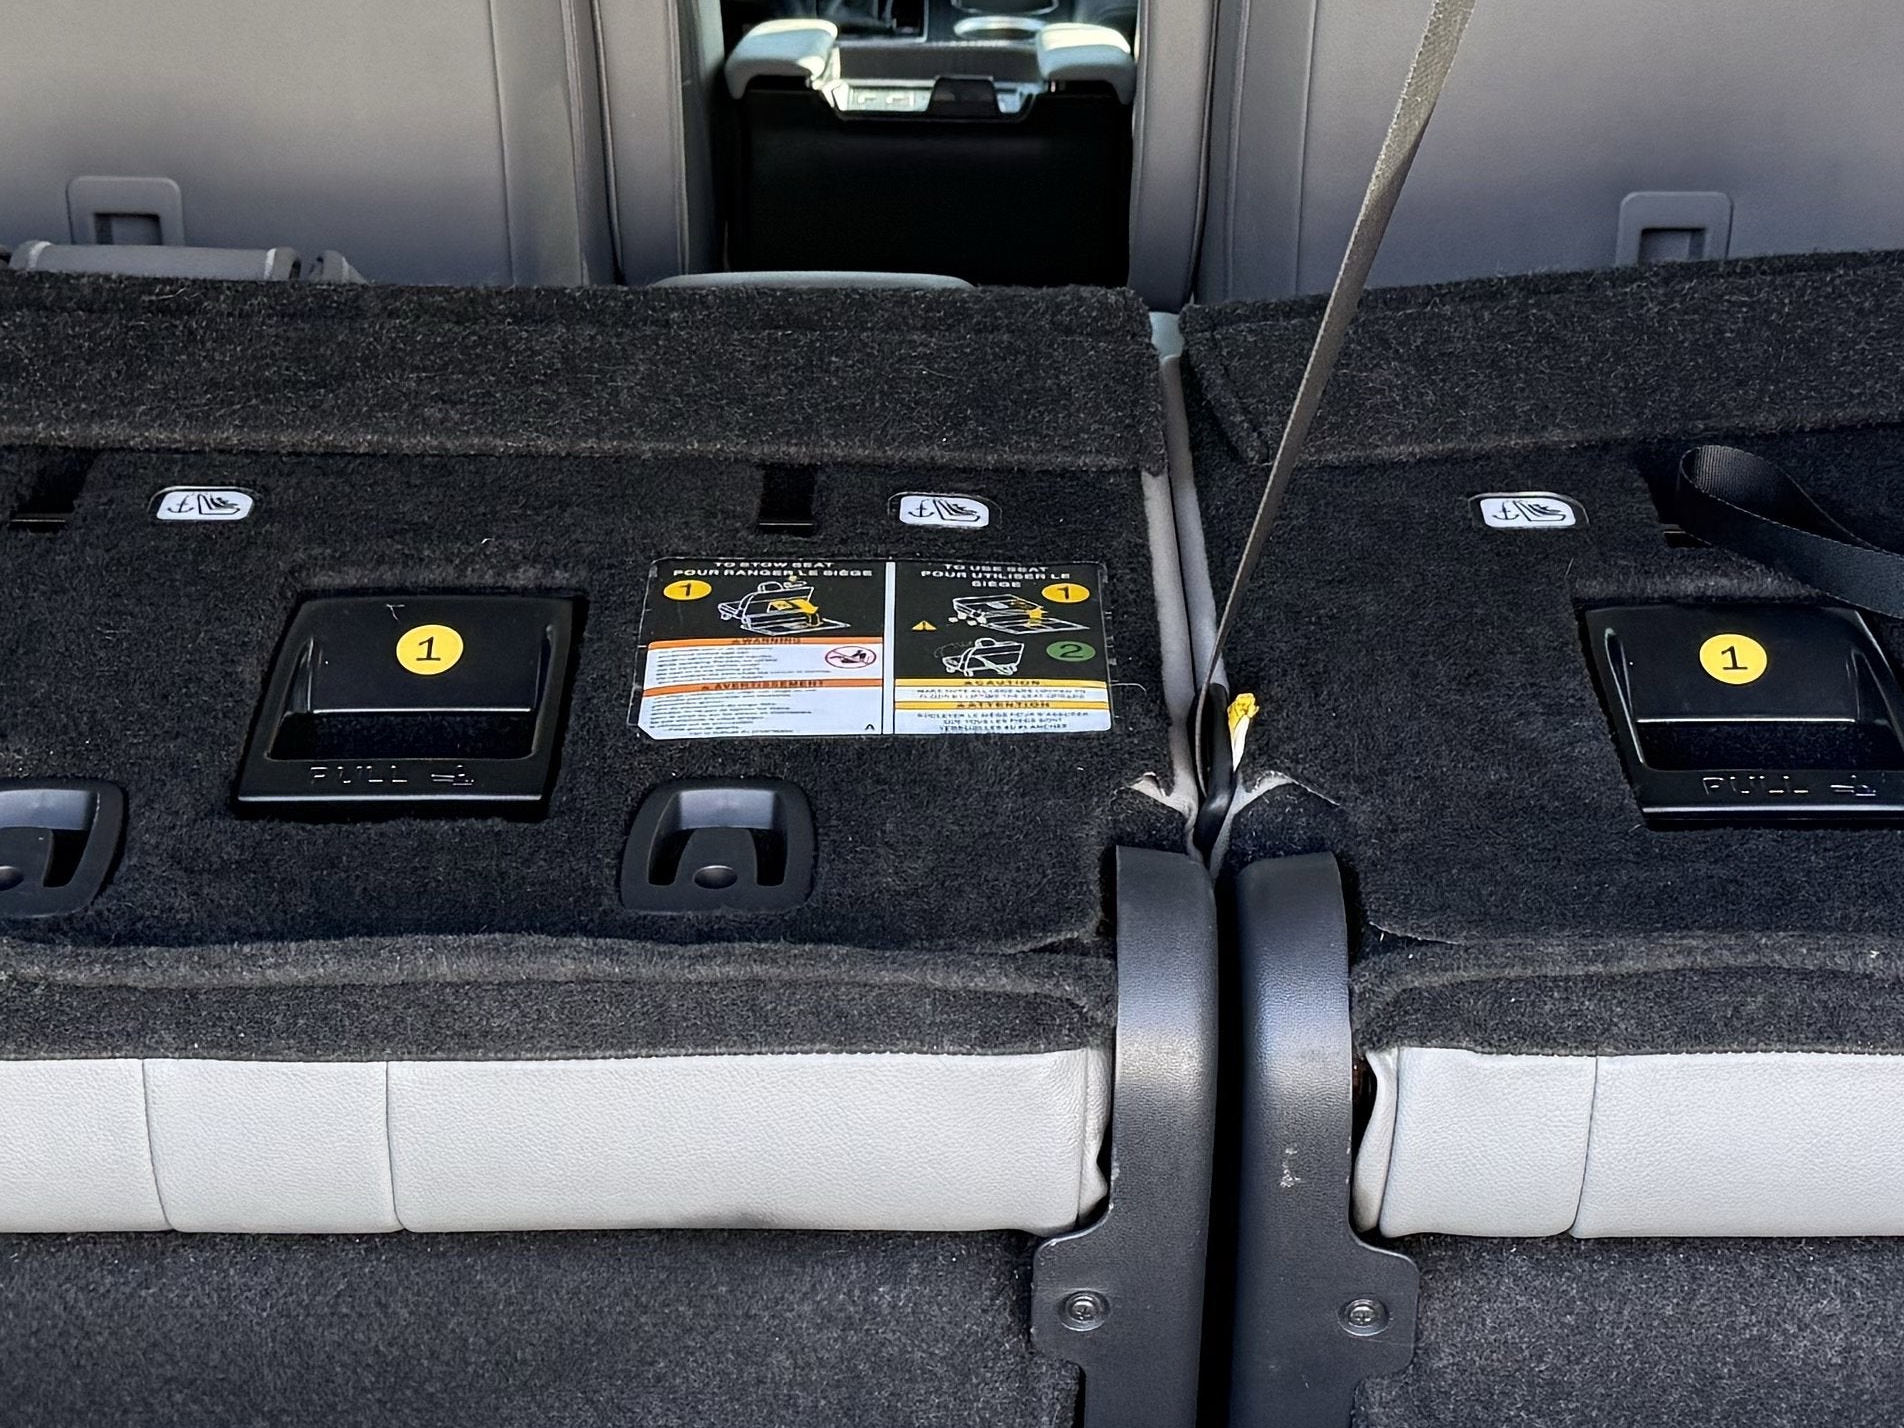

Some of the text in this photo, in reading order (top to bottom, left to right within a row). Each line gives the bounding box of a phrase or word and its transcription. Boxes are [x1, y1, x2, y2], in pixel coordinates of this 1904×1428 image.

[672, 569, 720, 577] POUR
[723, 569, 795, 577] RANGER
[971, 572, 1047, 580] UTILISER
[679, 582, 692, 597] 1
[1056, 586, 1070, 600] 1
[415, 636, 442, 662] 1
[1059, 643, 1084, 659] 2
[1720, 645, 1748, 671] 1
[308, 765, 408, 784] PULL
[1701, 774, 1809, 796] PULL
